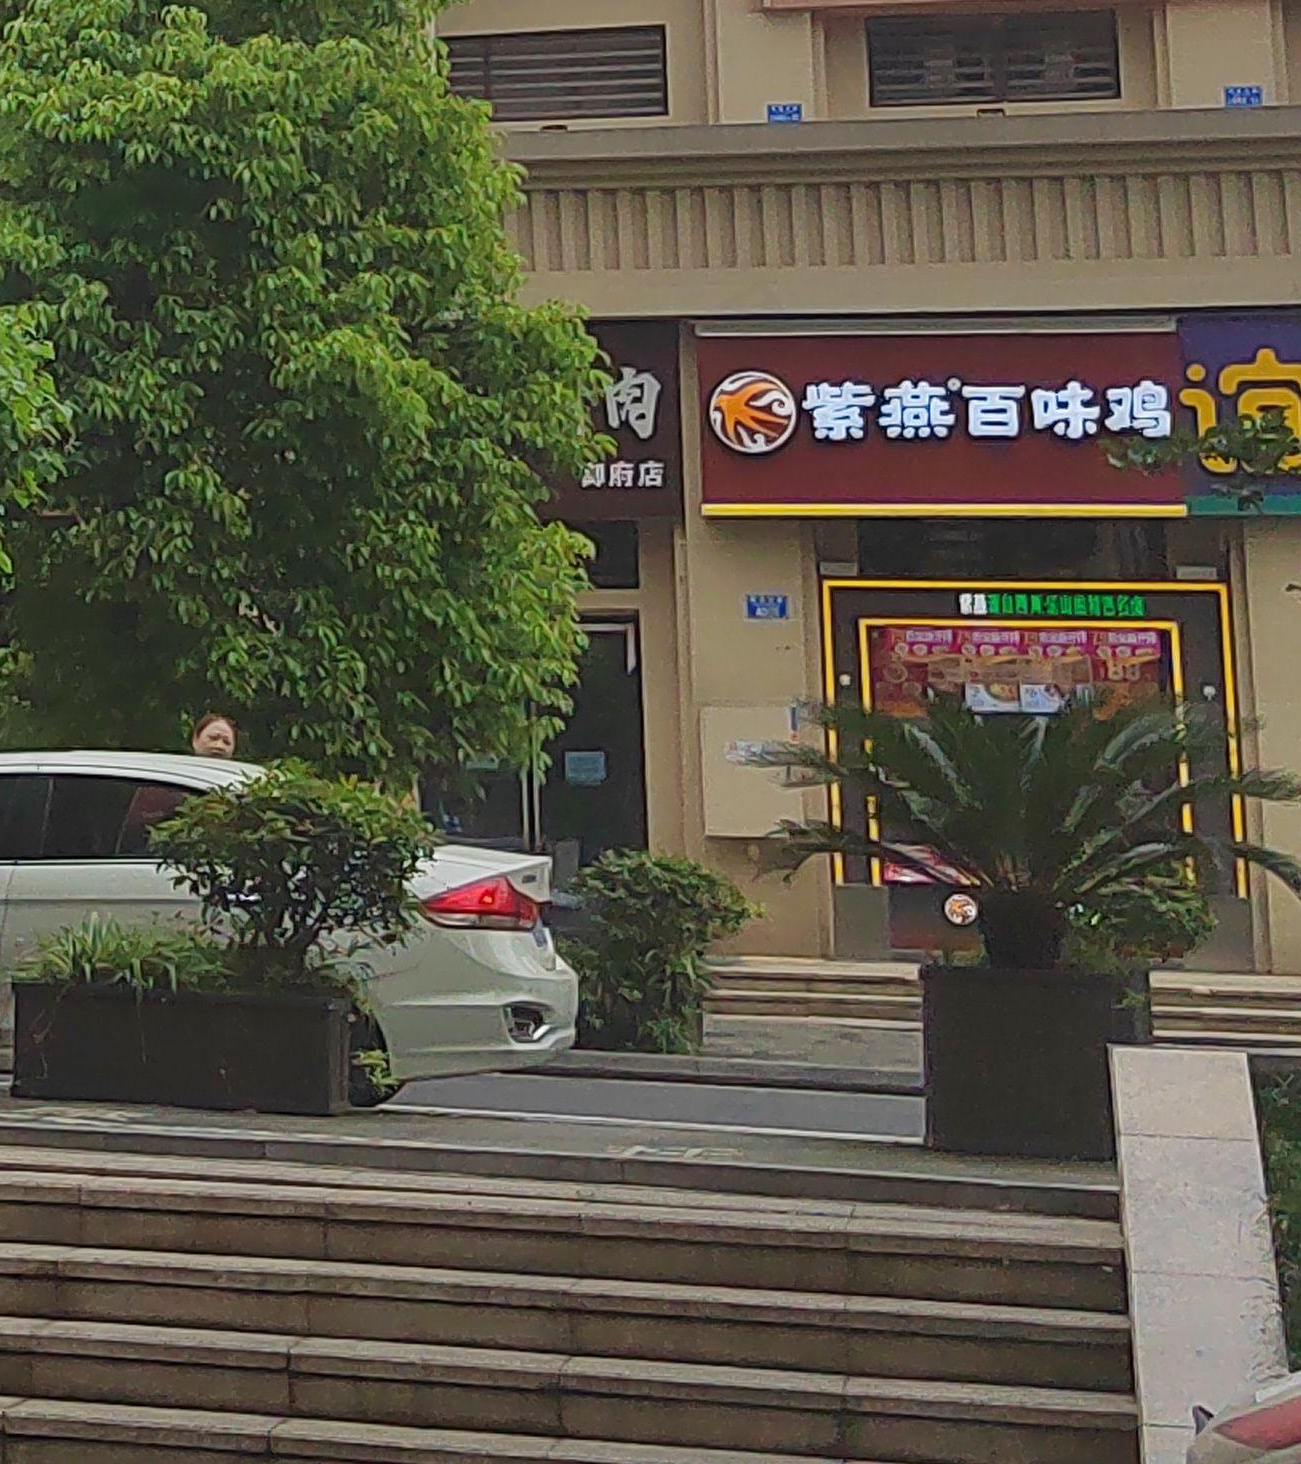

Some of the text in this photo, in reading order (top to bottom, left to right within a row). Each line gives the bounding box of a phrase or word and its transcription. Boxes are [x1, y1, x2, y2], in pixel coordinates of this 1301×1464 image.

[802, 379, 1173, 440] 紫燕百味鸡
